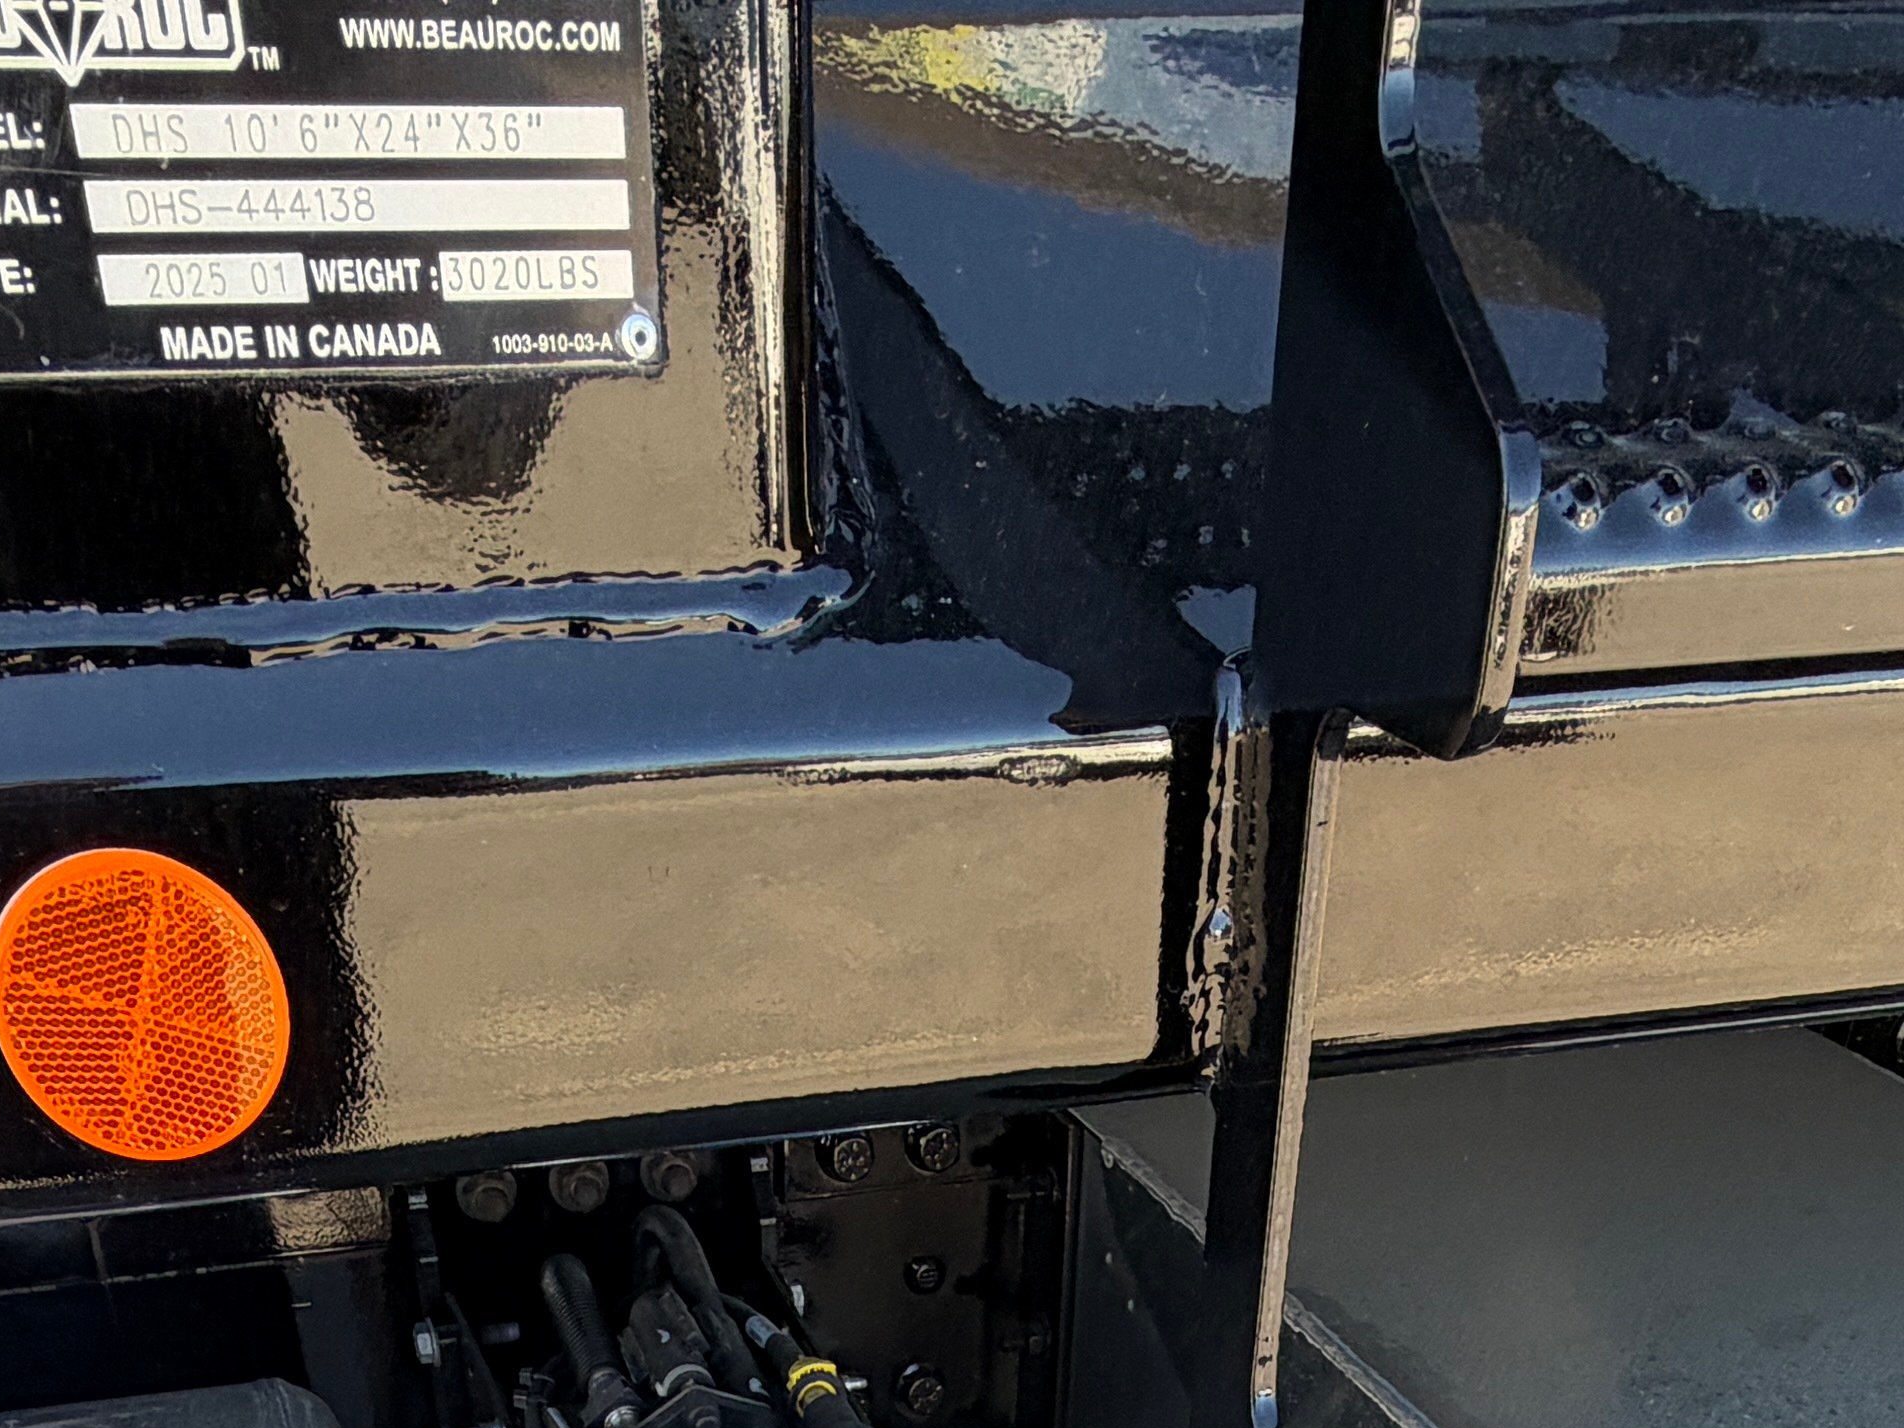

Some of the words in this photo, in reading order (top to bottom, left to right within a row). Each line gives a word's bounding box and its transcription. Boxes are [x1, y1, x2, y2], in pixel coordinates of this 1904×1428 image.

[339, 17, 621, 52] WWW.BEAUROC.COM
[111, 112, 189, 154] DHS
[125, 186, 375, 226] DHS-444138
[144, 261, 227, 299] 2025
[251, 260, 287, 296] 01
[447, 254, 599, 292] 3020LBS
[159, 325, 257, 361] MADE
[264, 324, 299, 359] IN
[308, 322, 441, 358] CANADA
[492, 332, 614, 355] 1003-910-03-A
